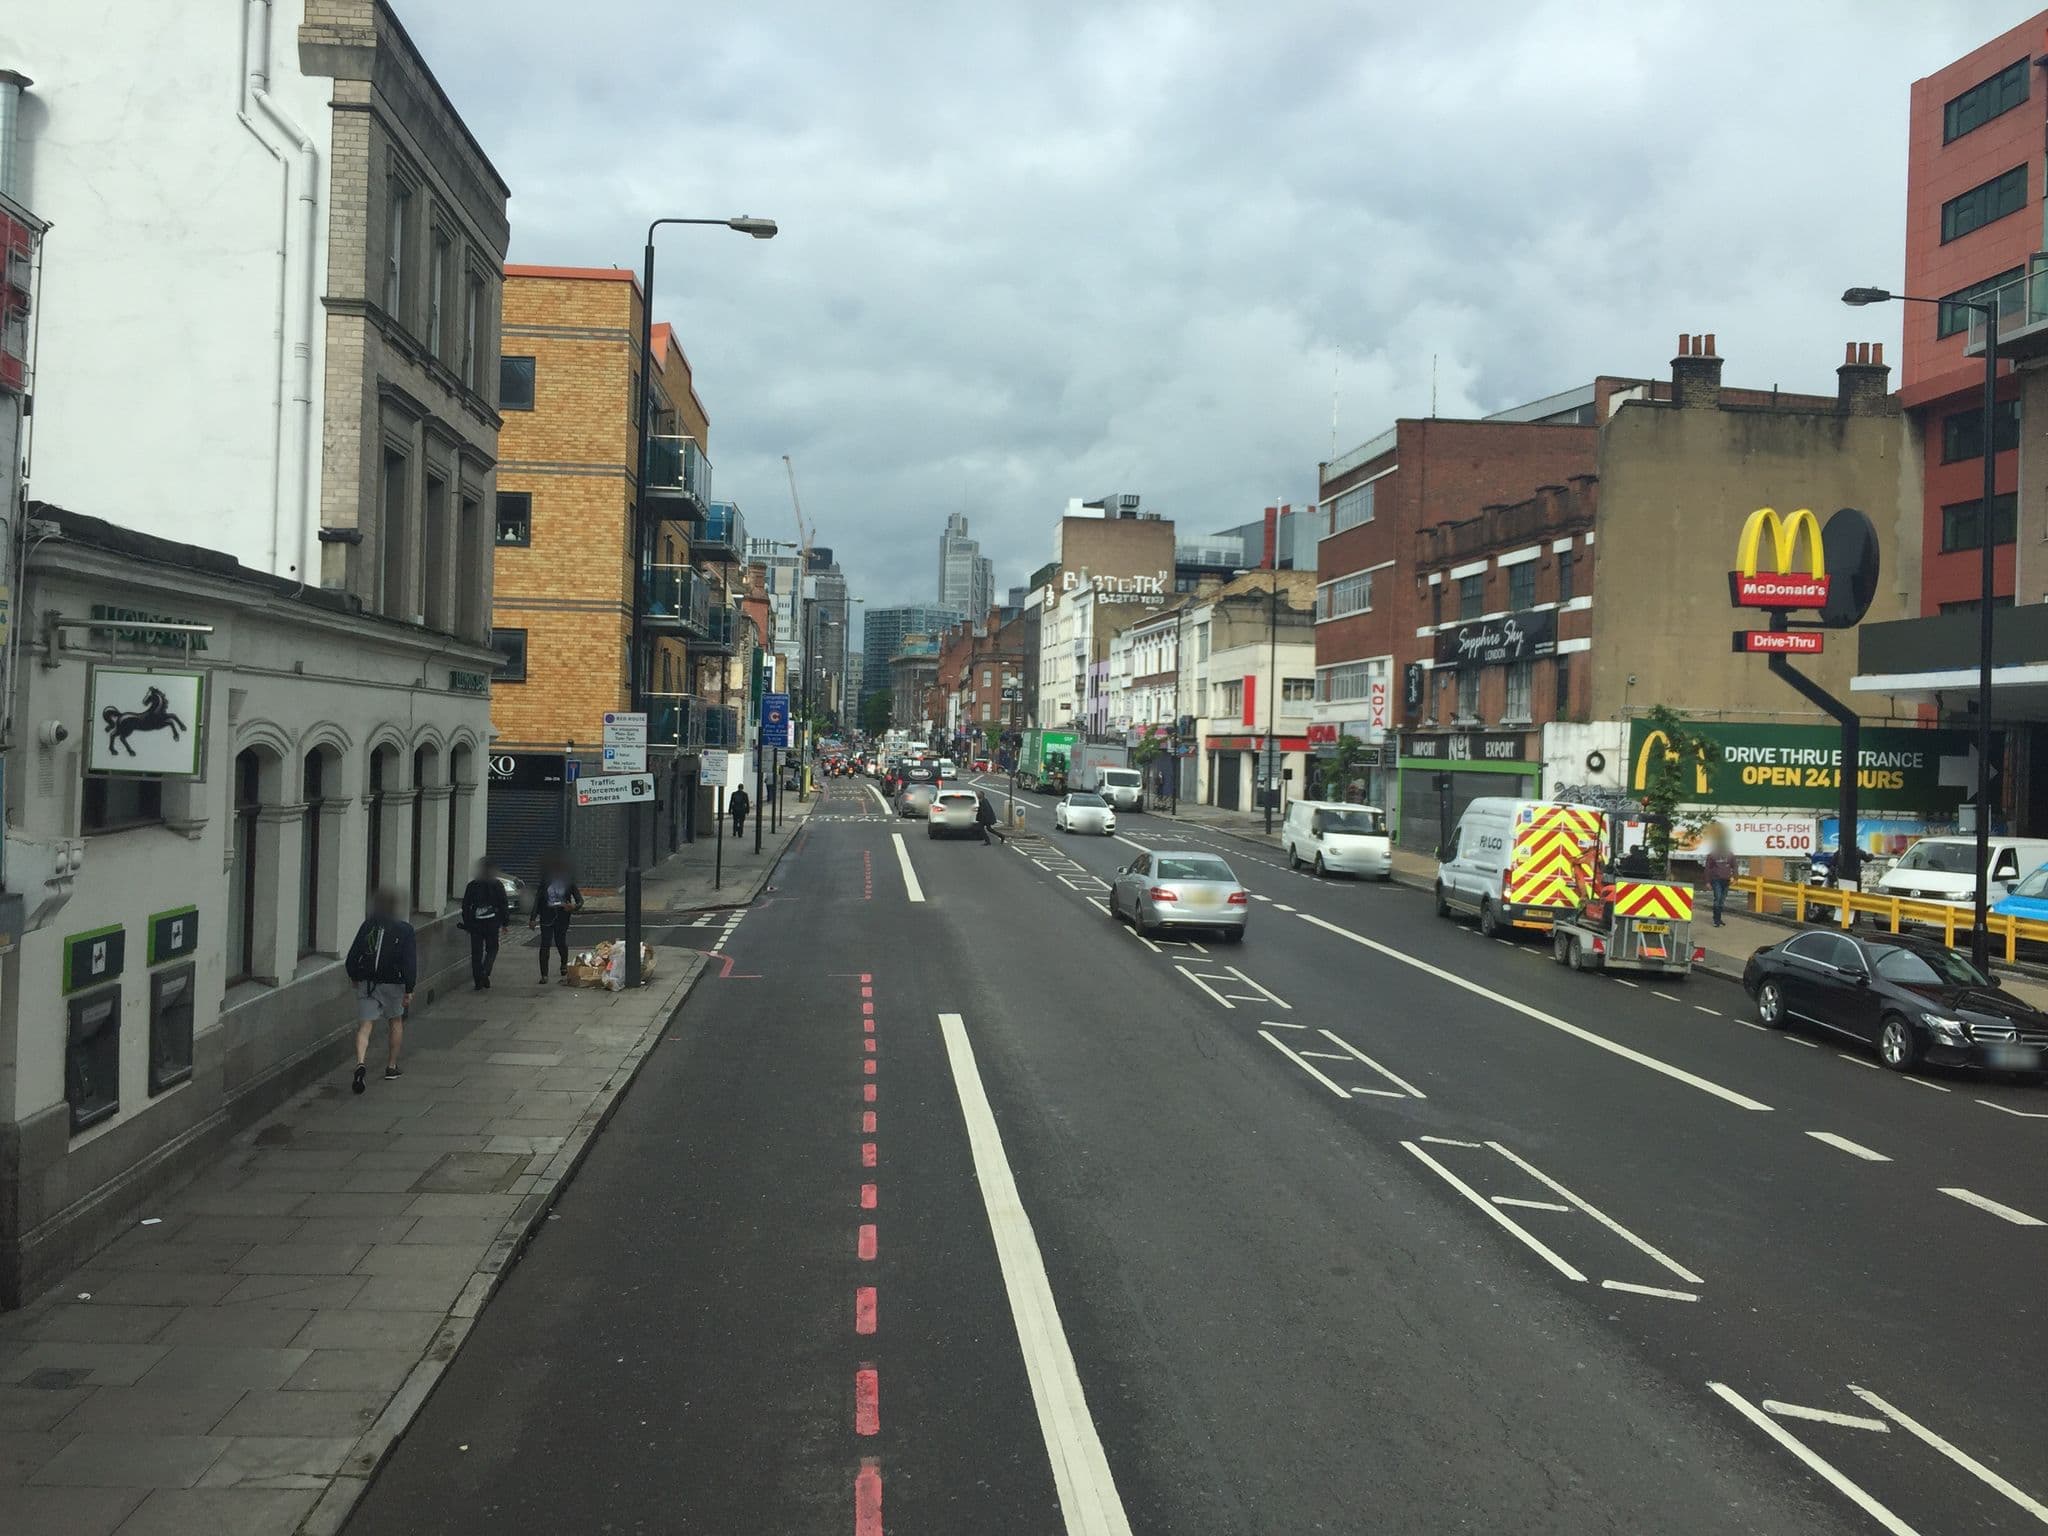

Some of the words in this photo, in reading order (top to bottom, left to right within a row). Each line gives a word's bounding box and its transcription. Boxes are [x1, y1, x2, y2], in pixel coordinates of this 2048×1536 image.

[1744, 584, 1826, 596] McDonald's
[1458, 627, 1500, 659] Sapphire
[1503, 619, 1525, 657] Sky
[1754, 635, 1815, 648] Drive-Thru
[1484, 648, 1506, 661] LONDON
[1372, 684, 1384, 727] NOVA
[1412, 741, 1437, 757] IMPORT
[1485, 741, 1515, 758] EXPORT
[1725, 746, 1777, 764] DRIVE
[1779, 748, 1828, 766] THRU
[1832, 750, 1924, 768] ETRANCE
[1742, 766, 1801, 787] OPEN
[1805, 767, 1830, 788] 24
[579, 786, 628, 795] enforcement
[1735, 823, 1742, 832] 3
[1744, 823, 1810, 833] FILET-O-FISH
[1766, 835, 1810, 850] £5.00
